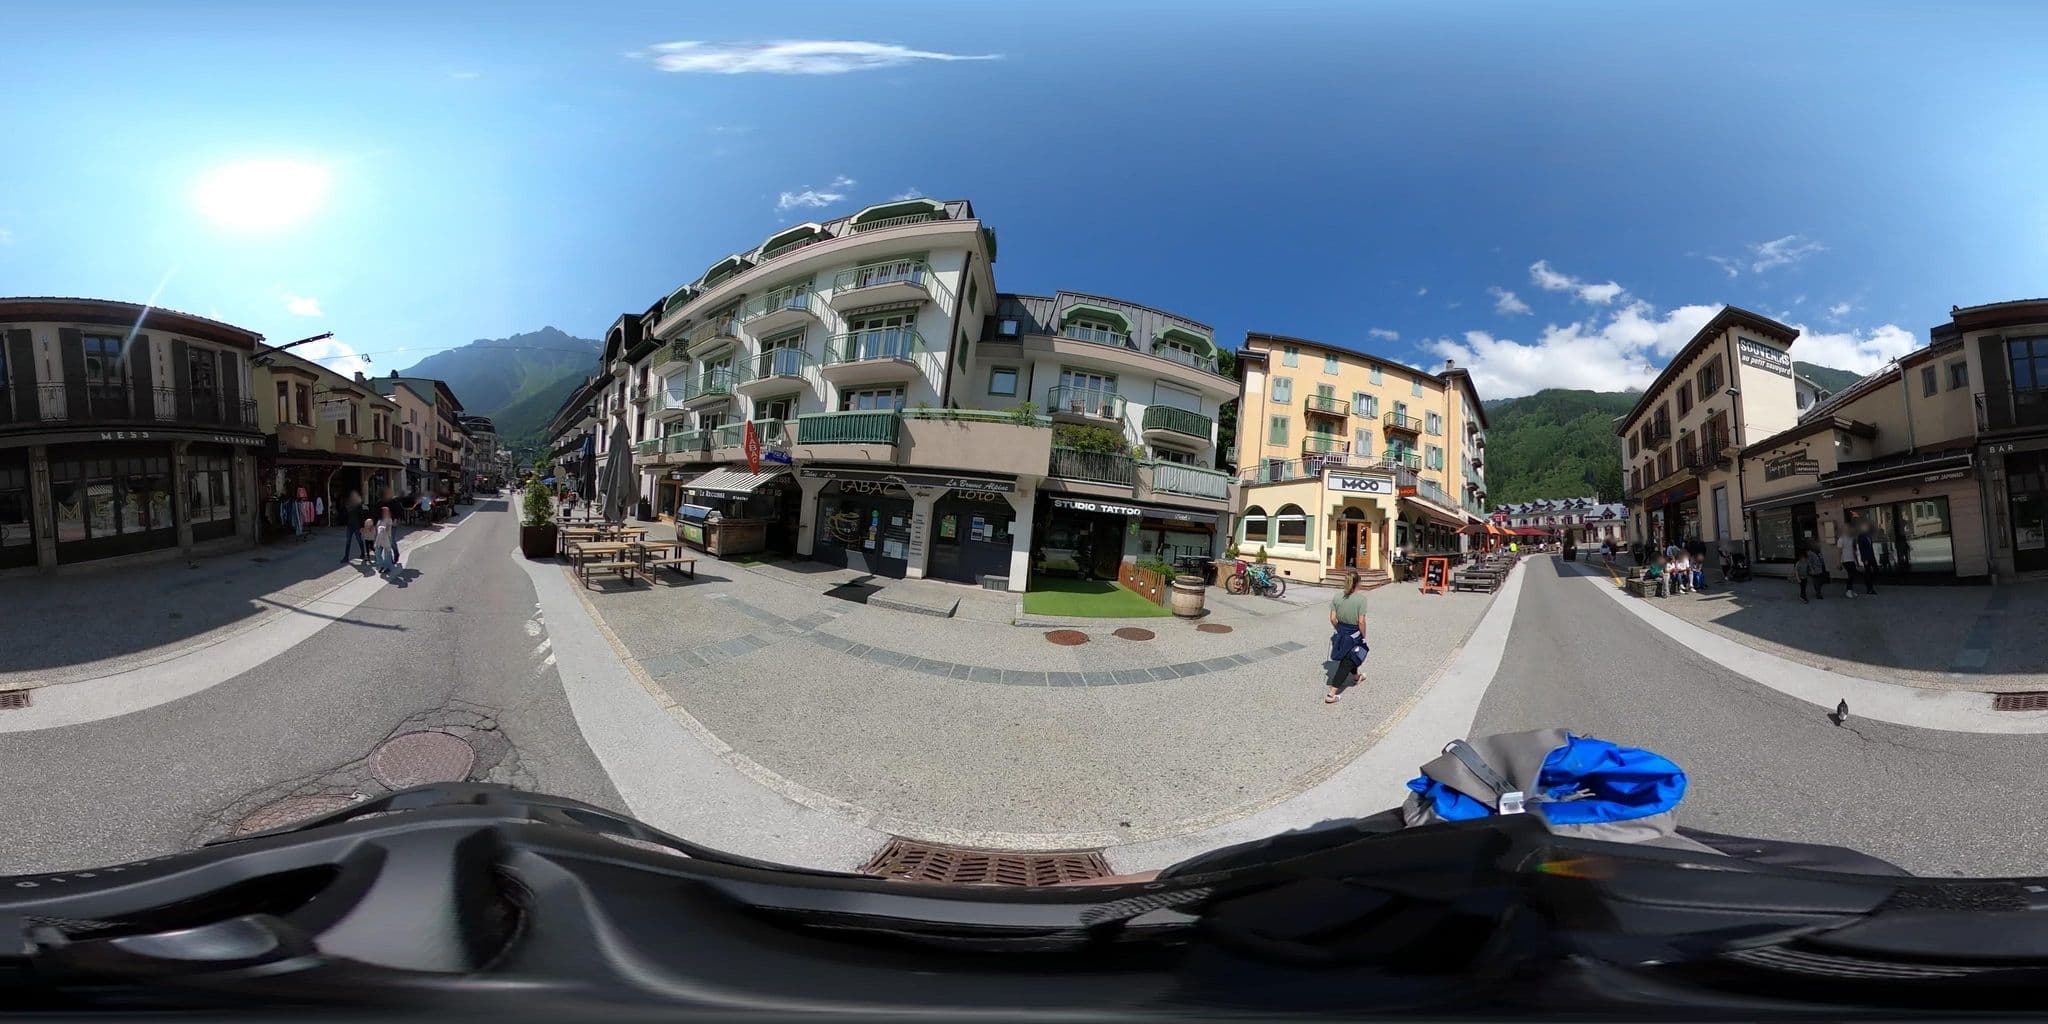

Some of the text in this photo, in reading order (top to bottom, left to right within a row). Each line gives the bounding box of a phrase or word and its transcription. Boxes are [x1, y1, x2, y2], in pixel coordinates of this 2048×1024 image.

[1740, 340, 1790, 366] SOUVENIRS
[101, 431, 149, 440] MESS
[214, 435, 264, 445] RESTAURANT
[749, 431, 758, 464] TABAC
[1989, 444, 2014, 454] BAR
[957, 489, 995, 501] LOTO
[1054, 500, 1096, 511] STUDIO
